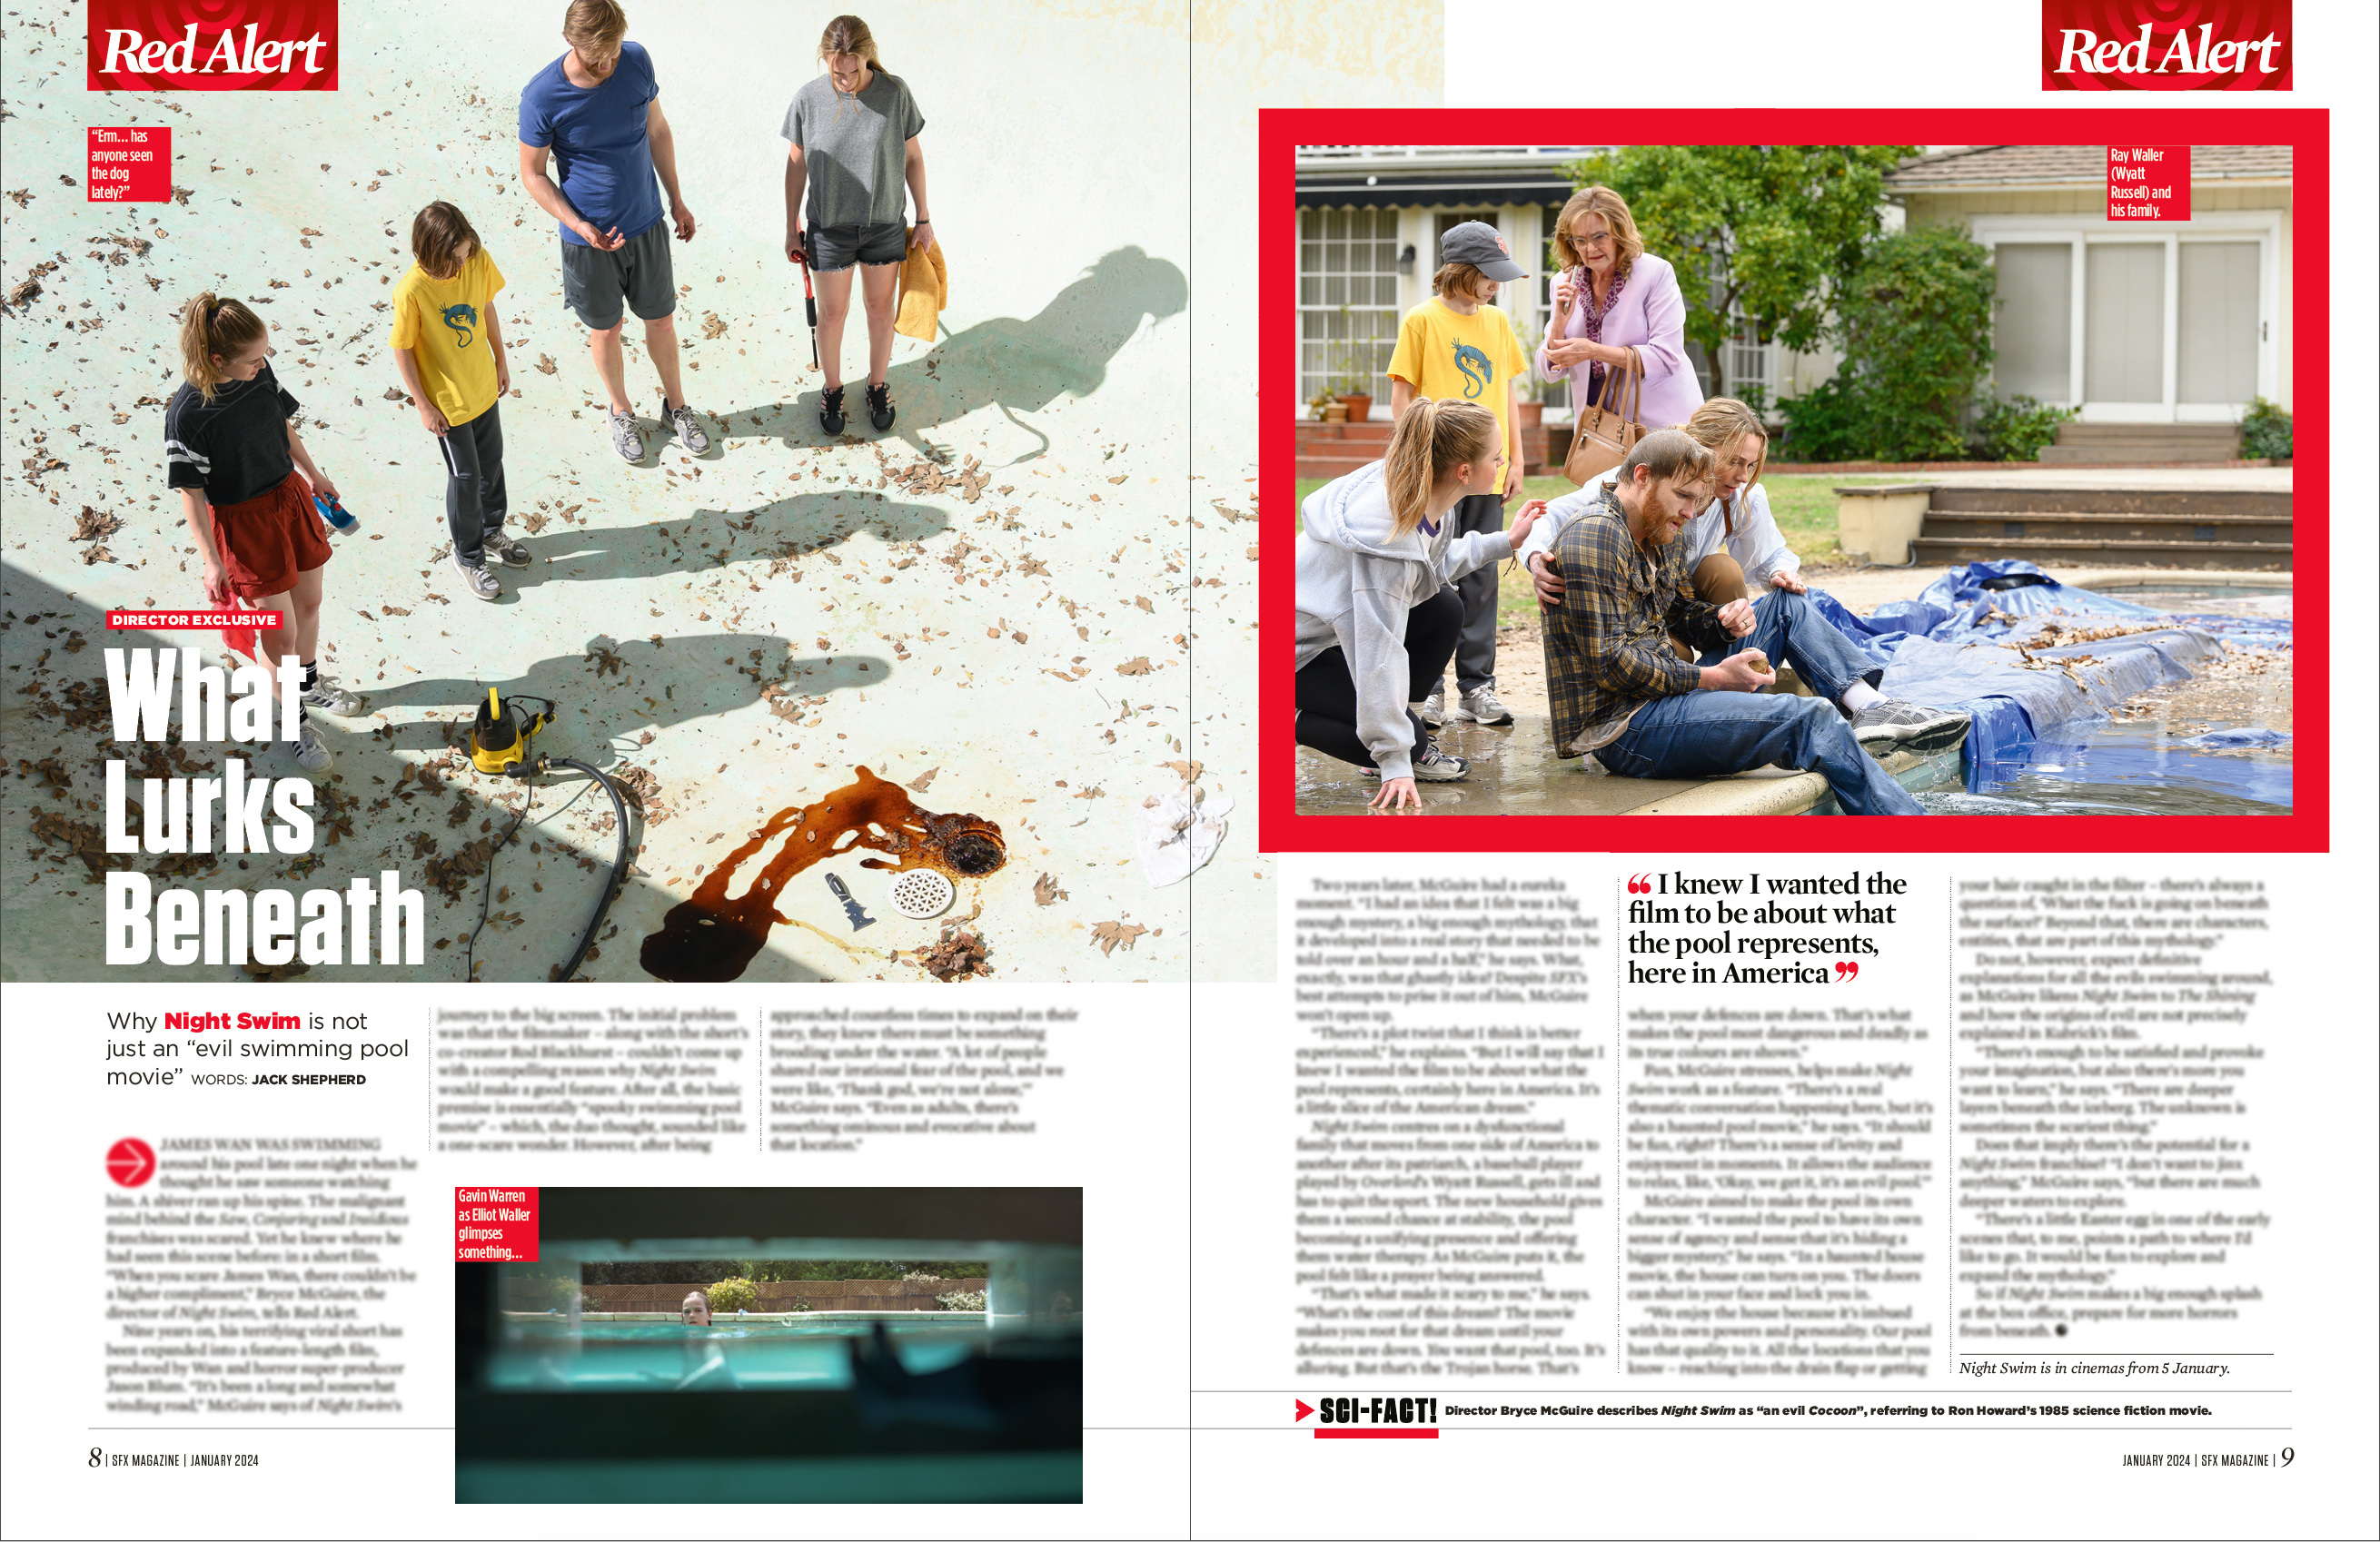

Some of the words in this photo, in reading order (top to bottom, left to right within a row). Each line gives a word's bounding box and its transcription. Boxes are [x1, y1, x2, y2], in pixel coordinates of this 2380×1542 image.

[98, 22, 199, 74] Red
[198, 22, 327, 74] Alert
[2053, 22, 2153, 74] Red
[2153, 22, 2282, 74] Alert
[92, 129, 129, 143] “Erm...
[131, 128, 148, 143] has
[91, 151, 128, 164] anyone
[129, 151, 154, 162] seen
[2111, 148, 2130, 164] Ray
[2131, 147, 2165, 162] Waller
[91, 165, 108, 180] the
[109, 165, 130, 183] dog
[2111, 166, 2146, 182] (Wyatt
[92, 184, 131, 201] lately?”
[2111, 184, 2150, 201] Russell)
[2151, 184, 2172, 199] and
[2111, 203, 2126, 217] his
[2127, 203, 2161, 219] family.
[112, 614, 189, 626] DIRECTOR
[192, 614, 277, 626] EXCLUSIVE
[104, 647, 308, 743] What
[105, 759, 315, 855] Lurks
[1312, 878, 1344, 892] Two
[1344, 881, 1381, 895] years
[1419, 878, 1479, 892] McGuire
[1481, 878, 1508, 892] had
[1520, 878, 1566, 892] eureka
[1657, 873, 1669, 895] I
[1674, 870, 1744, 895] knew
[1750, 873, 1760, 895] I
[1766, 870, 1860, 895] wanted
[1865, 870, 1908, 895] the
[1959, 881, 1990, 895] your
[1993, 877, 2021, 892] hair
[2023, 877, 2070, 895] caught
[2087, 878, 2111, 892] the
[2112, 877, 2146, 892] filter
[2207, 878, 2254, 894] always
[105, 869, 425, 965] Beneath
[1627, 899, 1681, 924] film
[1683, 904, 1711, 924] to
[1716, 899, 1749, 924] be
[1753, 899, 1828, 924] about
[1831, 899, 1897, 924] what
[1627, 929, 1671, 954] the
[1675, 929, 1731, 960] pool
[1737, 934, 1879, 960] represents,
[1628, 959, 1687, 984] here
[1691, 961, 1717, 984] in
[1721, 961, 1830, 984] America
[106, 1012, 158, 1033] Why
[164, 1012, 232, 1033] Night
[236, 1012, 301, 1030] Swim
[309, 1012, 324, 1030] is
[332, 1013, 368, 1030] not
[437, 1011, 490, 1025] journey
[509, 1007, 531, 1022] the
[533, 1008, 556, 1024] big
[608, 1007, 635, 1022] The
[637, 1008, 678, 1022] initial
[679, 1007, 738, 1024] problem
[769, 1007, 850, 1024] approached
[850, 1007, 915, 1022] countless
[917, 1010, 955, 1022] times
[972, 1007, 1024, 1024] expand
[1046, 1007, 1080, 1022] their
[1628, 1007, 1666, 1022] when
[1668, 1011, 1699, 1024] your
[1701, 1007, 1761, 1022] defences
[1763, 1011, 1785, 1022] are
[1876, 1007, 1912, 1022] what
[105, 1039, 146, 1061] just
[153, 1043, 179, 1057] an
[187, 1039, 232, 1057] “evil
[240, 1039, 352, 1061] swimming
[361, 1039, 408, 1061] pool
[107, 1067, 183, 1085] movie”
[191, 1073, 248, 1085] WORDS:
[251, 1074, 288, 1085] JACK
[291, 1074, 367, 1085] SHEPHERD
[157, 1138, 213, 1152] JAMES
[213, 1138, 253, 1152] WAN
[254, 1138, 290, 1152] WAS
[291, 1138, 382, 1152] SWIMMING
[158, 1156, 209, 1171] around
[211, 1156, 232, 1171] his
[233, 1156, 264, 1173] pool
[266, 1157, 292, 1171] late
[293, 1160, 320, 1171] one
[320, 1156, 358, 1173] night
[359, 1156, 399, 1171] when
[458, 1188, 487, 1202] Gavin
[488, 1188, 527, 1202] Warren
[458, 1211, 471, 1221] as
[472, 1207, 497, 1221] Elliot
[498, 1207, 531, 1221] Waller
[458, 1225, 503, 1242] glimpses
[1959, 1323, 1994, 1338] from
[1959, 1360, 1998, 1378] Night
[1999, 1361, 2037, 1374] Swim
[2040, 1361, 2051, 1374] is
[2055, 1361, 2068, 1374] in
[2071, 1361, 2126, 1374] cinemas
[2124, 1360, 2160, 1378] from
[2161, 1362, 2171, 1374] 5
[2171, 1362, 2231, 1378] January.
[1320, 1397, 1437, 1424] SCI-FACT!
[1445, 1405, 1498, 1416] Director
[1501, 1406, 1538, 1418] Bryce
[1541, 1405, 1594, 1416] McGuire
[1596, 1405, 1659, 1416] describes
[1661, 1405, 1699, 1418] Night
[1700, 1405, 1736, 1416] Swim
[1738, 1407, 1754, 1416] as
[1756, 1406, 1780, 1416] “an
[1781, 1405, 1805, 1416] evil
[1809, 1405, 1868, 1418] Cocoon”,
[1870, 1405, 1929, 1418] referring
[1930, 1406, 1945, 1416] to
[1949, 1406, 1974, 1416] Ron
[1977, 1405, 2038, 1416] Howard’s
[2038, 1405, 2069, 1416] 1985
[2072, 1405, 2121, 1416] science
[2123, 1405, 2166, 1416] fiction
[2169, 1405, 2212, 1416] movie.
[88, 1447, 103, 1468] 8
[112, 1454, 129, 1467] SFX
[132, 1454, 180, 1467] MAGAZINE
[190, 1454, 233, 1467] JANUARY
[234, 1454, 259, 1467] 2024
[2122, 1454, 2164, 1467] JANUARY
[2167, 1454, 2191, 1467] 2024
[2201, 1454, 2218, 1467] SFX
[2221, 1454, 2269, 1467] MAGAZINE
[2280, 1447, 2295, 1468] 9
